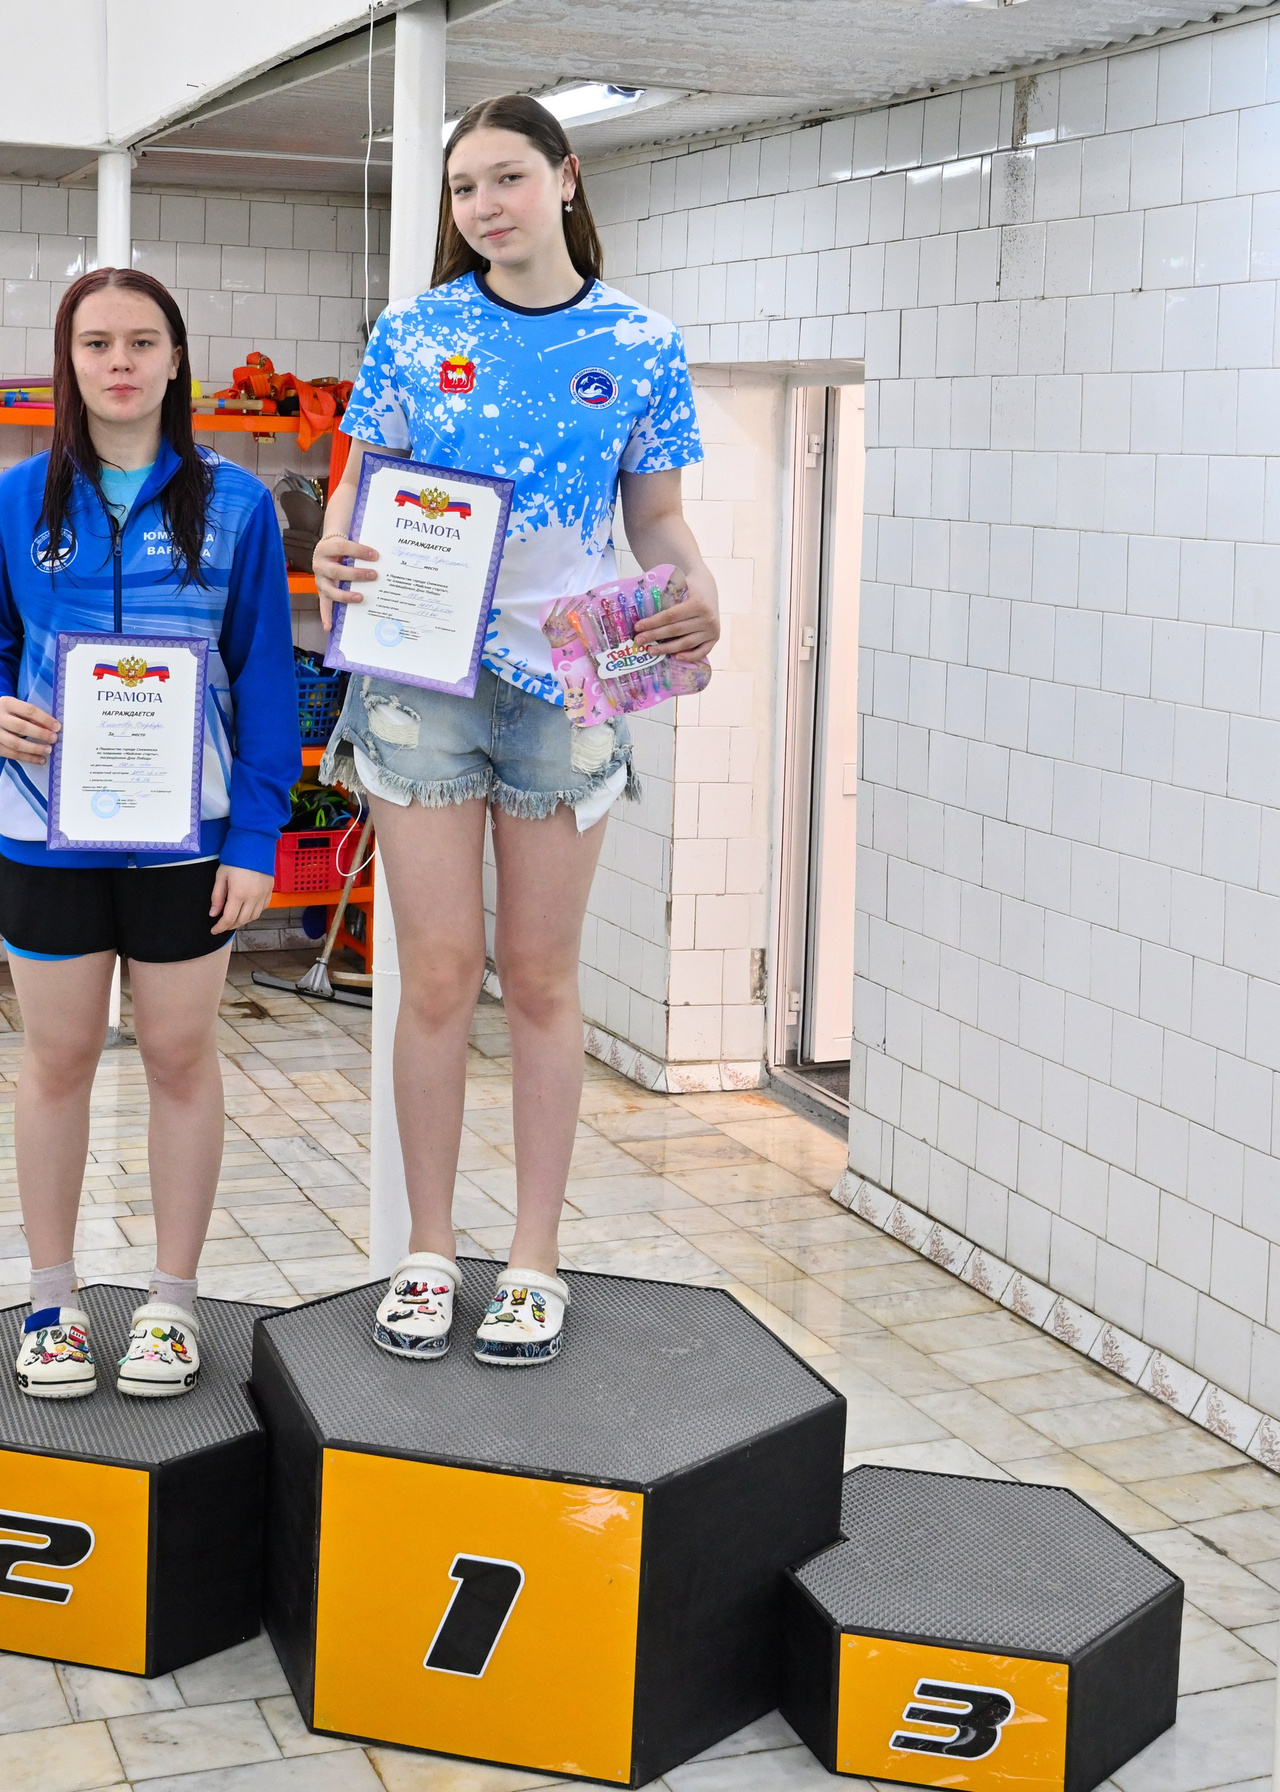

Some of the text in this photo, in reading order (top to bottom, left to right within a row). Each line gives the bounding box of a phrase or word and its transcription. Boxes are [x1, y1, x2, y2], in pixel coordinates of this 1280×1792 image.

[395, 517, 461, 540] ГРАМОТА
[397, 538, 451, 553] НАГРАЖДАЕТСЯ
[97, 690, 163, 703] ГРАМОТА
[423, 1553, 526, 1678] 1
[889, 1678, 1017, 1761] 3
